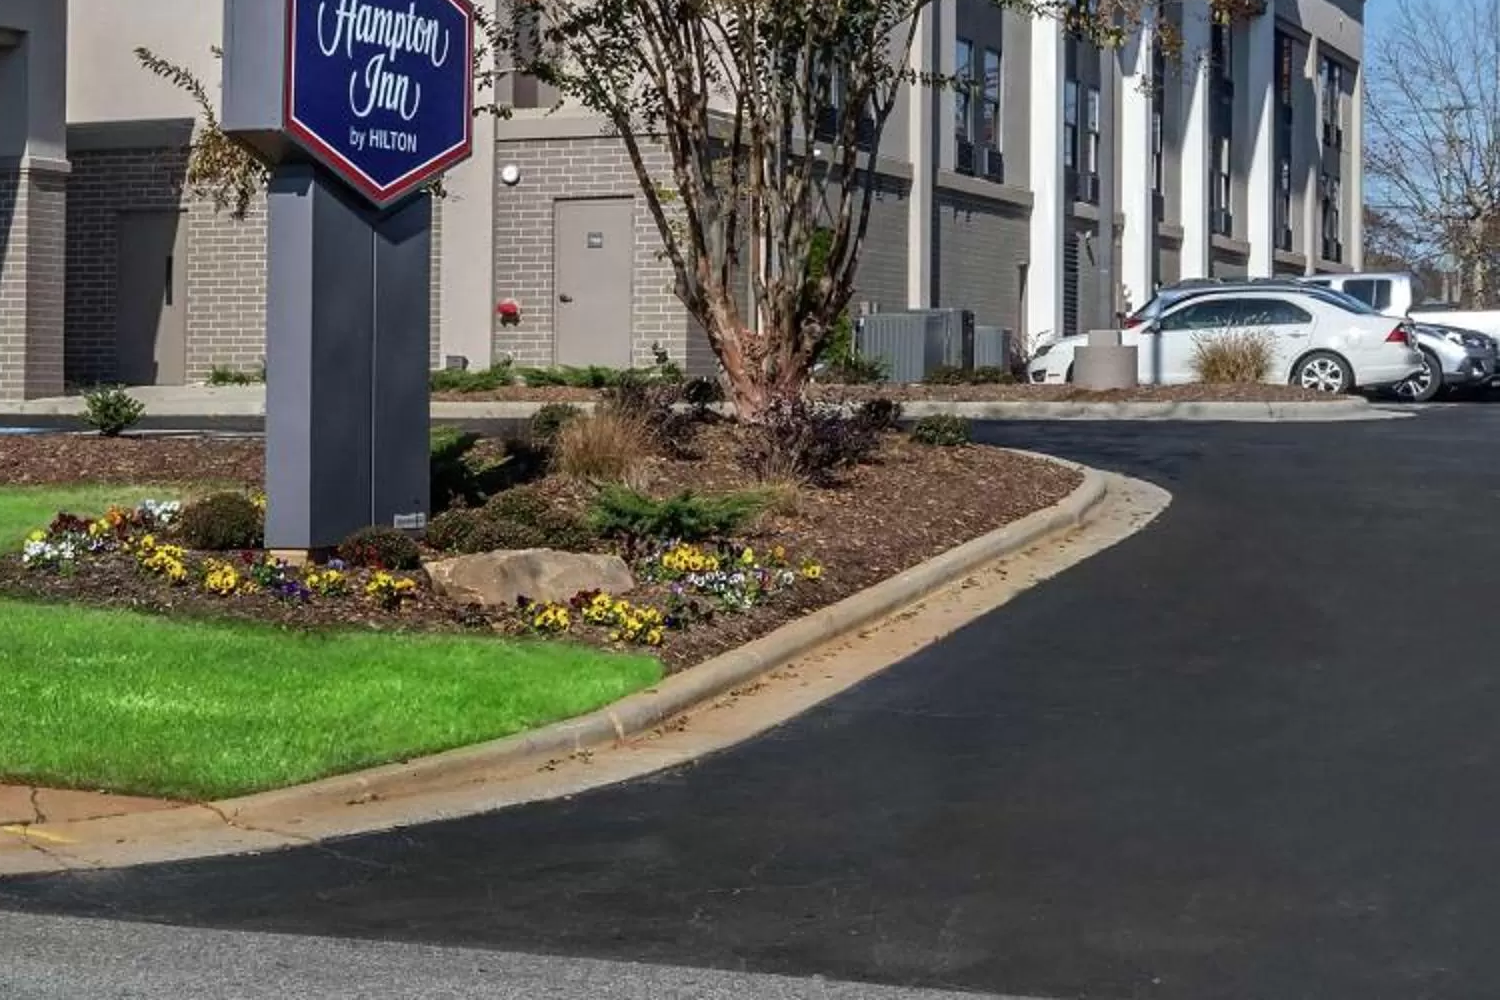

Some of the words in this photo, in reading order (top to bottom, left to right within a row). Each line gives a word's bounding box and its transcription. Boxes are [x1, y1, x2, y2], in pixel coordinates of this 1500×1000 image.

[349, 53, 421, 120] Inn
[350, 126, 366, 151] by
[368, 129, 417, 152] HILTON
